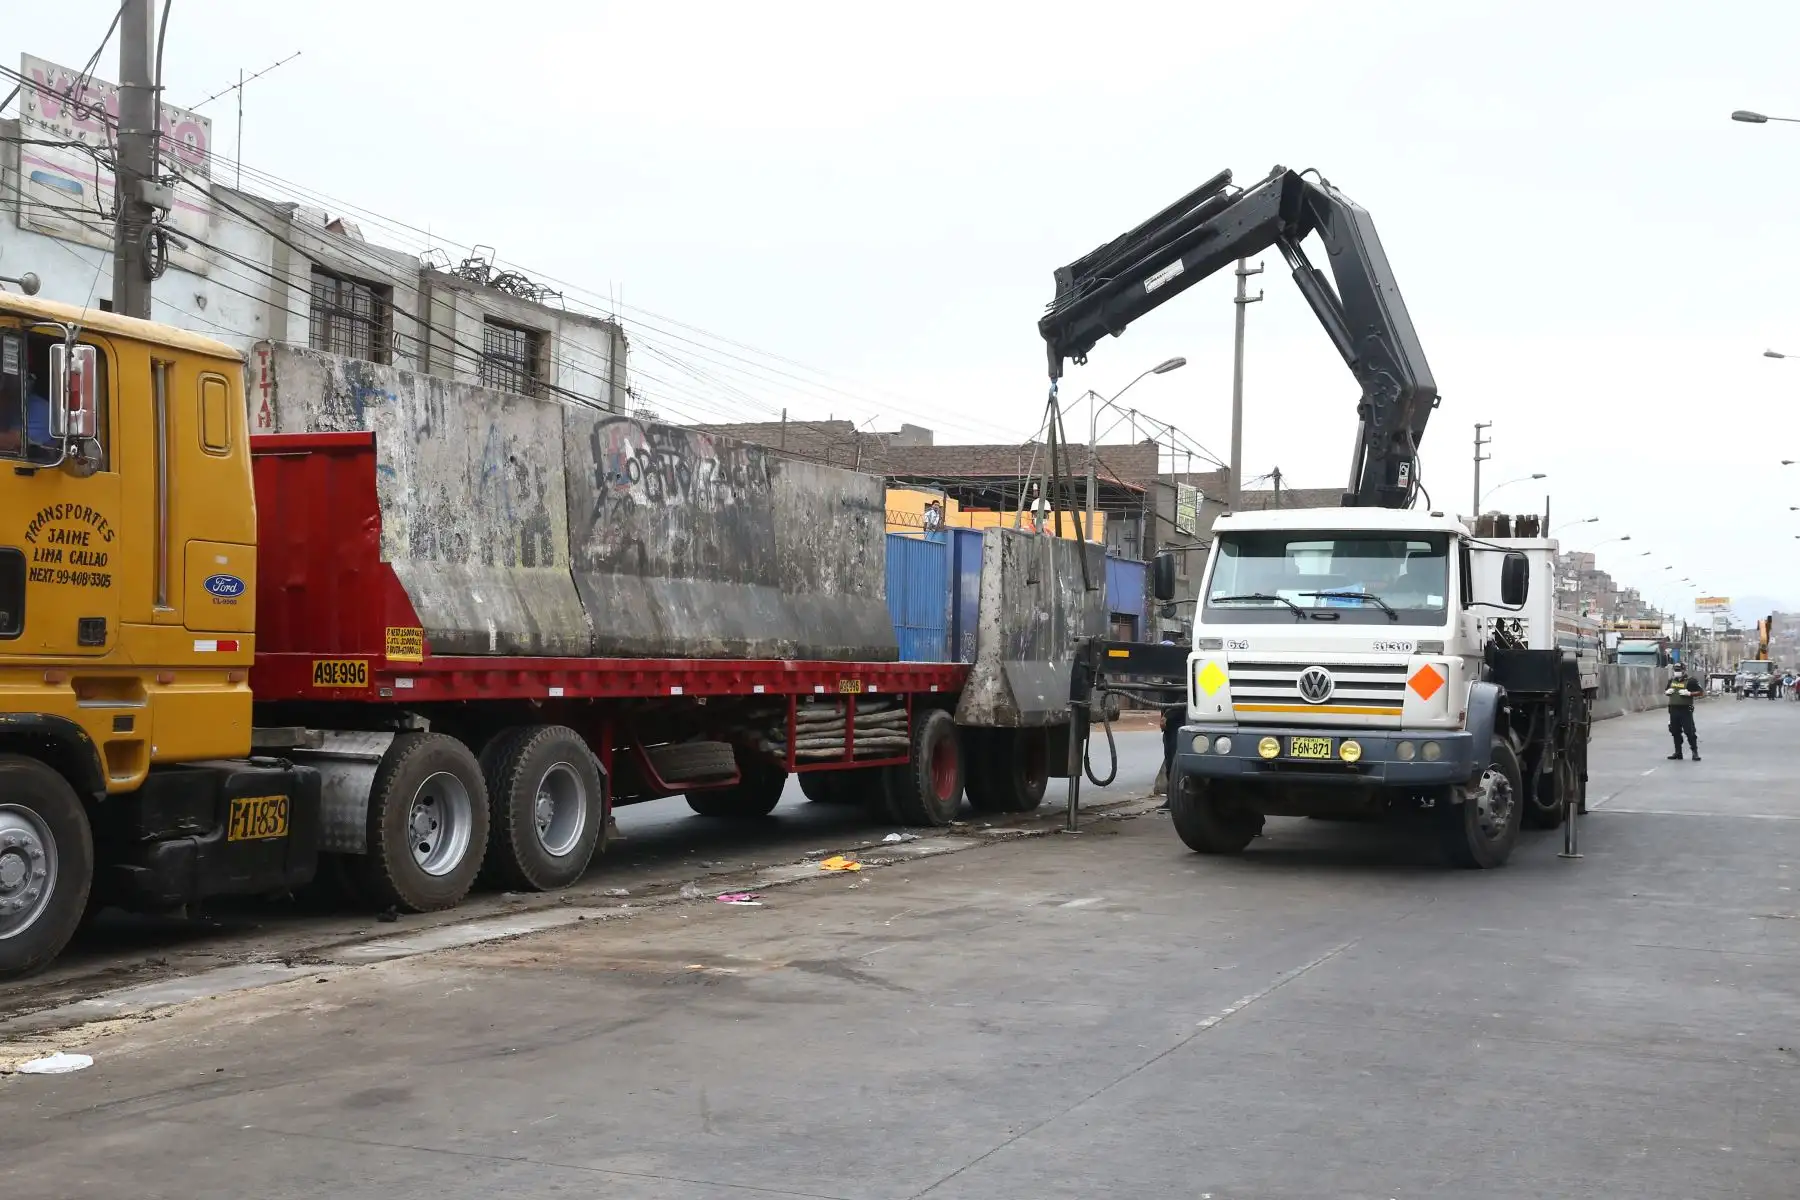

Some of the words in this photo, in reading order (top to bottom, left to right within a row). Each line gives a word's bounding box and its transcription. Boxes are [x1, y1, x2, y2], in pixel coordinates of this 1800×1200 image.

[31, 68, 207, 166] VEO
[25, 503, 115, 544] TRANSPORTES
[48, 528, 90, 547] JAIME
[33, 547, 63, 563] LIMA
[69, 550, 108, 567] CALLAO
[212, 576, 238, 593] Ford
[1227, 639, 1249, 650] 6x4
[314, 661, 366, 685] A9E-996
[1301, 670, 1331, 699] VW
[1292, 741, 1330, 756] F6N-871
